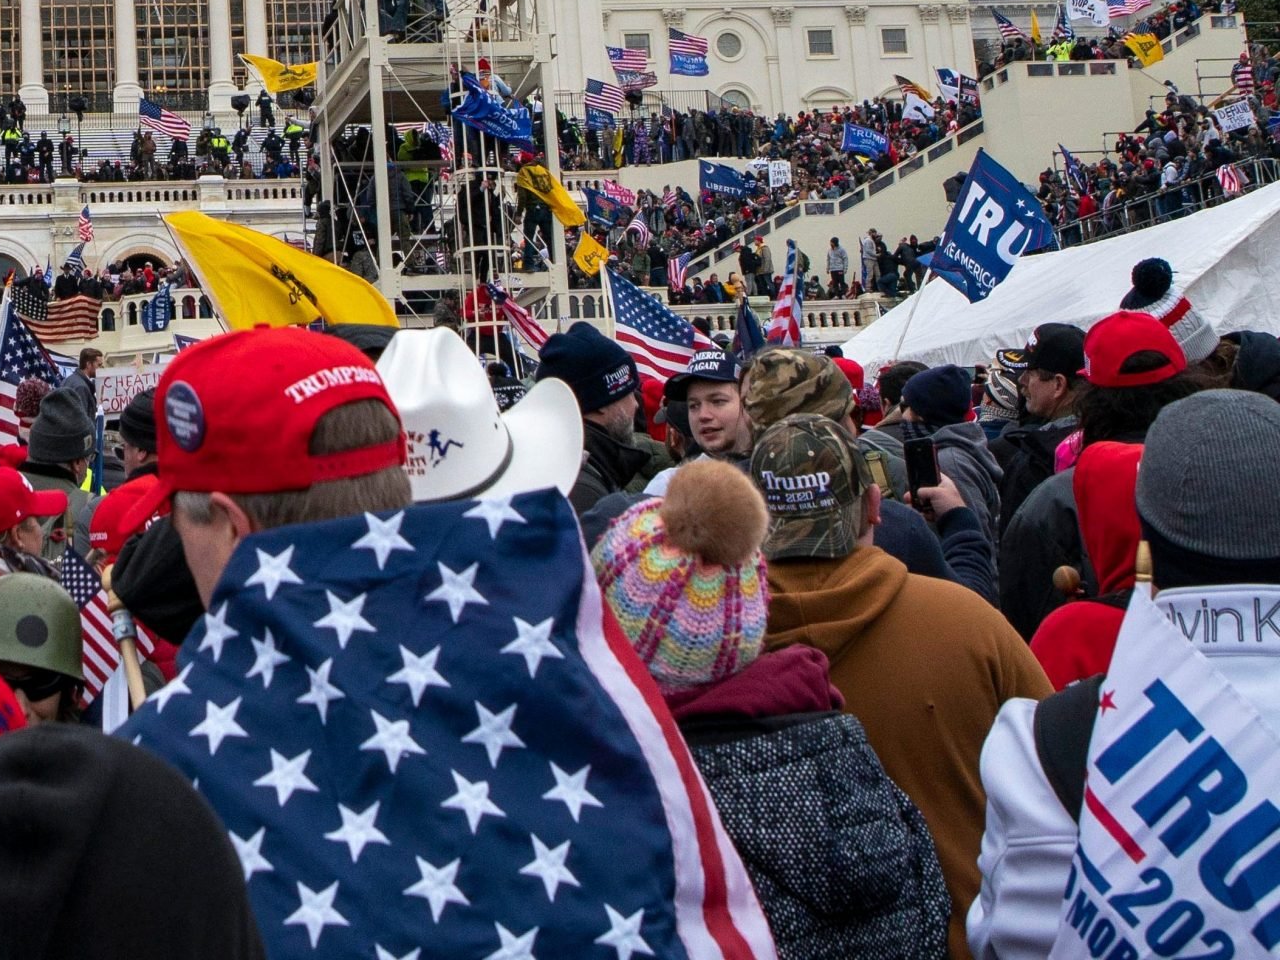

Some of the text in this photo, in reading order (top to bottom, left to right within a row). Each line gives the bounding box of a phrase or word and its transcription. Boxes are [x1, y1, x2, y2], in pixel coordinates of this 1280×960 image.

[1229, 114, 1245, 124] THE
[851, 126, 886, 144] TRUMP
[705, 181, 743, 196] LIBERTY
[954, 251, 997, 290] AMERICA
[604, 364, 630, 384] Trump
[693, 361, 720, 372] AGAIN
[761, 470, 831, 493] Trump
[785, 490, 813, 503] 2020
[800, 501, 818, 511] BULL
